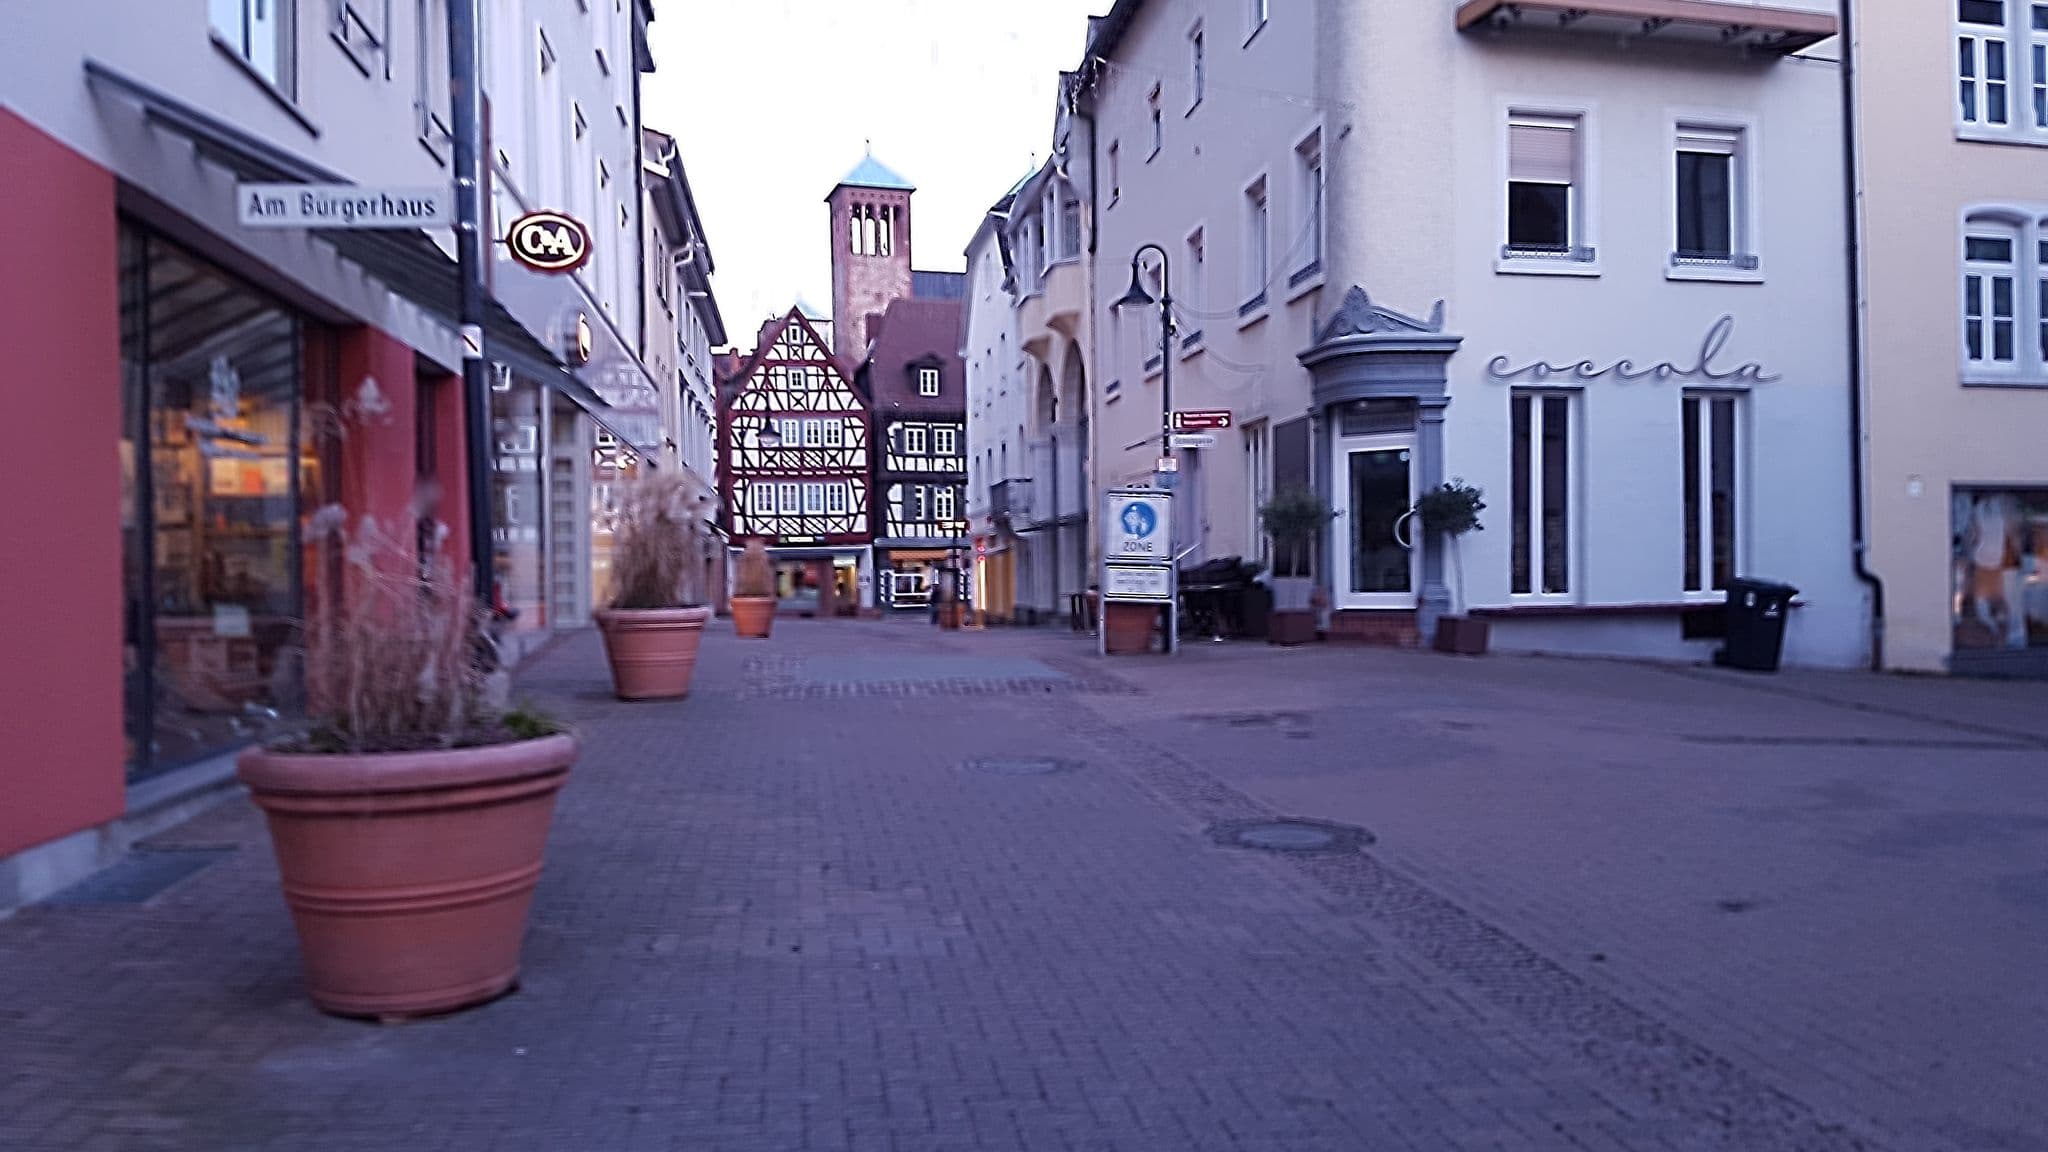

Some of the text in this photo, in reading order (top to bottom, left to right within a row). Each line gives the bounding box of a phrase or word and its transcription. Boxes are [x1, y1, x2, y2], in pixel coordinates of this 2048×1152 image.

[249, 192, 286, 216] Am
[521, 224, 575, 256] C&A
[1123, 541, 1153, 552] ZONE
